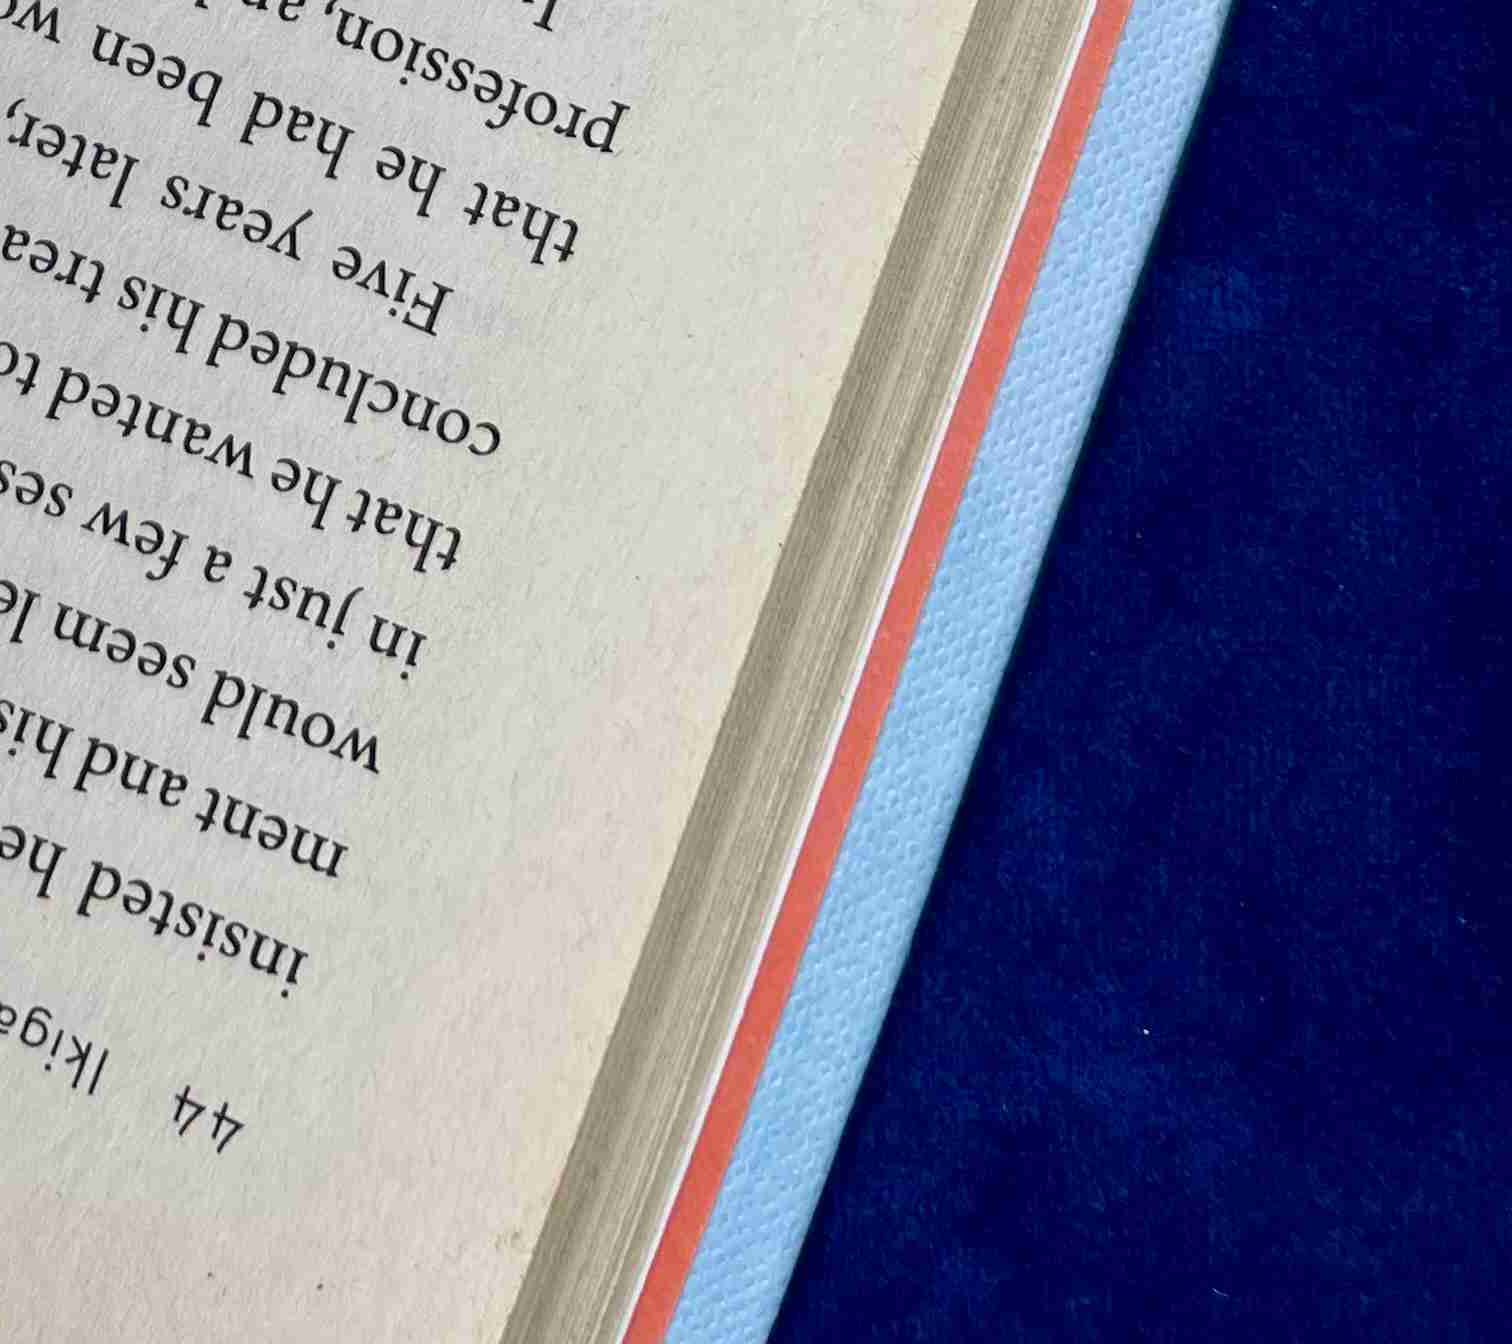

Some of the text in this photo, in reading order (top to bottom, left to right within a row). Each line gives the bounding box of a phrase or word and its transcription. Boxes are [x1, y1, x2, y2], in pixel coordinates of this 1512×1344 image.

[5, 96, 140, 209] later,
[159, 174, 314, 262] years
[116, 274, 206, 355] his
[331, 245, 455, 337] Five
[204, 312, 501, 457] concluded
[52, 600, 197, 689] seem
[199, 668, 379, 775] would
[71, 736, 189, 807] and
[193, 786, 349, 878] ment
[75, 859, 309, 999] insisted
[172, 1084, 245, 1155] 44
